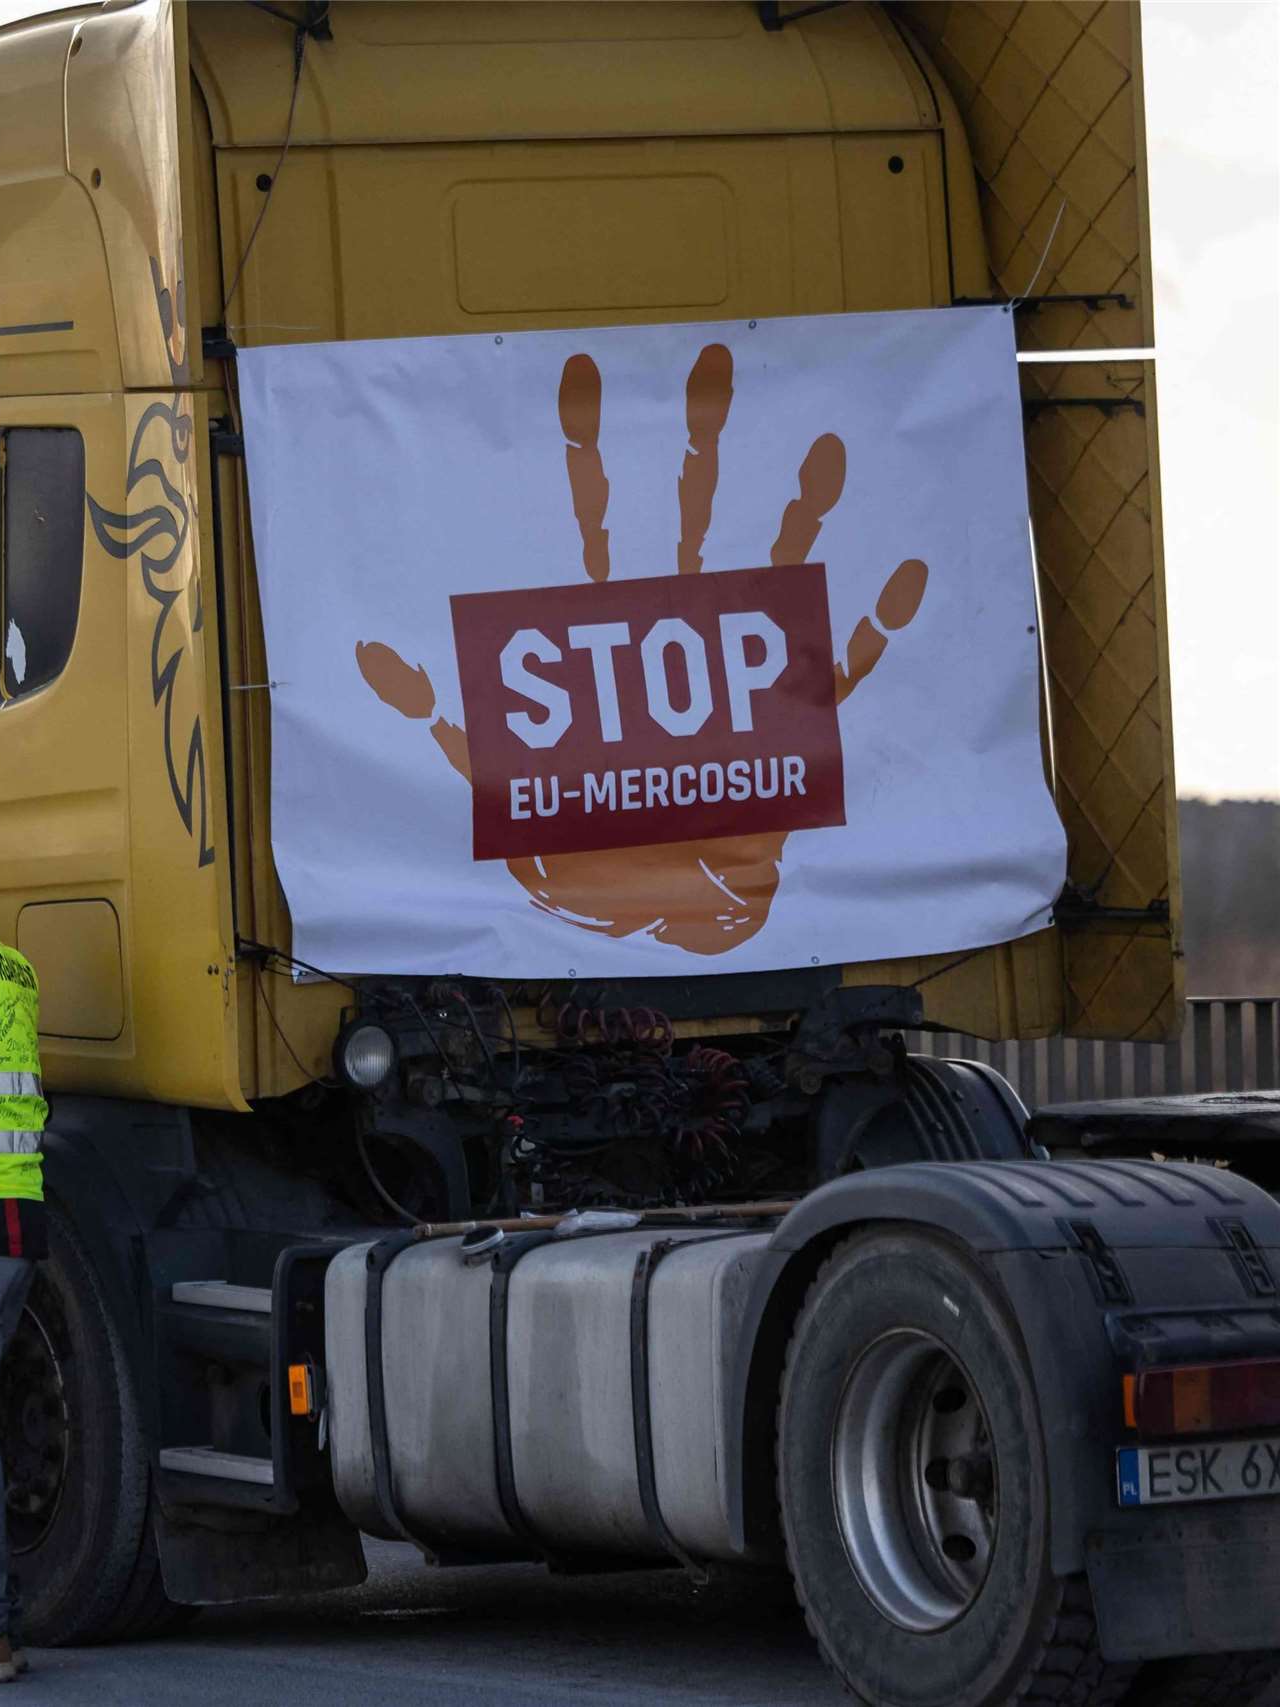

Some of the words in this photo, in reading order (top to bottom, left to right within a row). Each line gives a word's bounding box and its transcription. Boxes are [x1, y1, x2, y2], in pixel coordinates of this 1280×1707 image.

[500, 611, 788, 749] STOP
[510, 756, 807, 820] EU-MERCOSUR
[1122, 1482, 1138, 1497] PL
[1148, 1448, 1224, 1498] ESK
